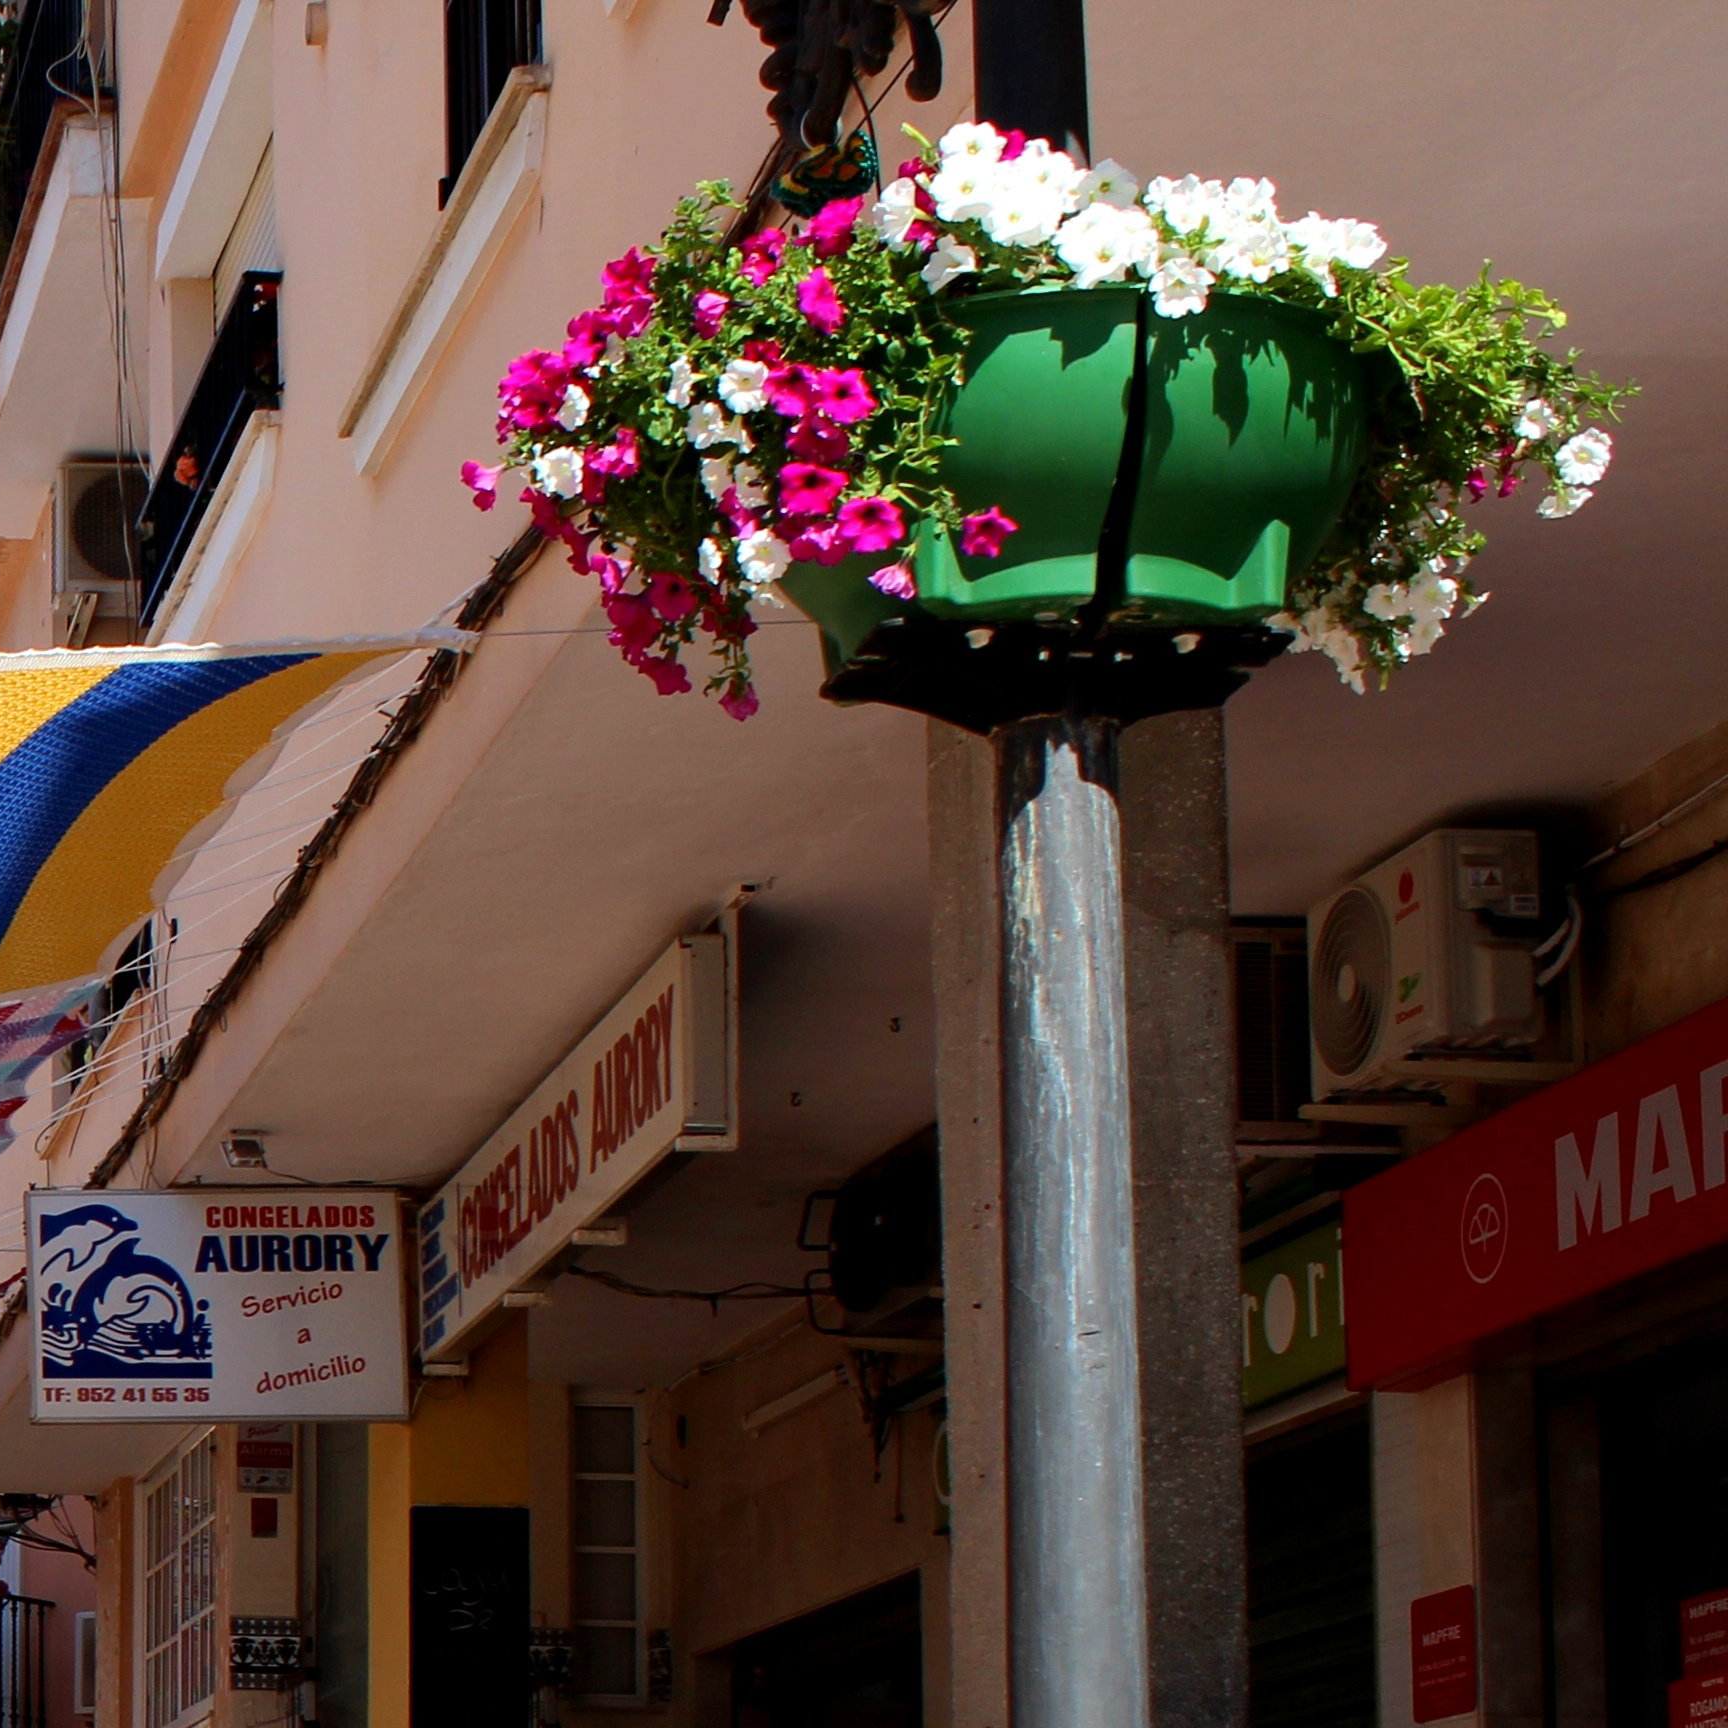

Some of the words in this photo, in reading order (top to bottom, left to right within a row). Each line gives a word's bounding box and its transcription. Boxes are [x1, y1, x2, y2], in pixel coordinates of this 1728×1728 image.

[462, 1089, 579, 1289] CONGELADOS
[591, 983, 673, 1174] AURORY
[206, 1205, 375, 1229] CONGELADOS
[195, 1234, 390, 1273] AURORY
[241, 1281, 343, 1318] Servicio
[297, 1327, 312, 1344] a
[256, 1355, 366, 1394] domicilio
[43, 1387, 72, 1402] TF:
[77, 1387, 116, 1402] 952
[122, 1387, 147, 1402] 41
[152, 1387, 178, 1402] 55
[184, 1387, 210, 1402] 35
[1422, 1624, 1462, 1647] MAPFRE
